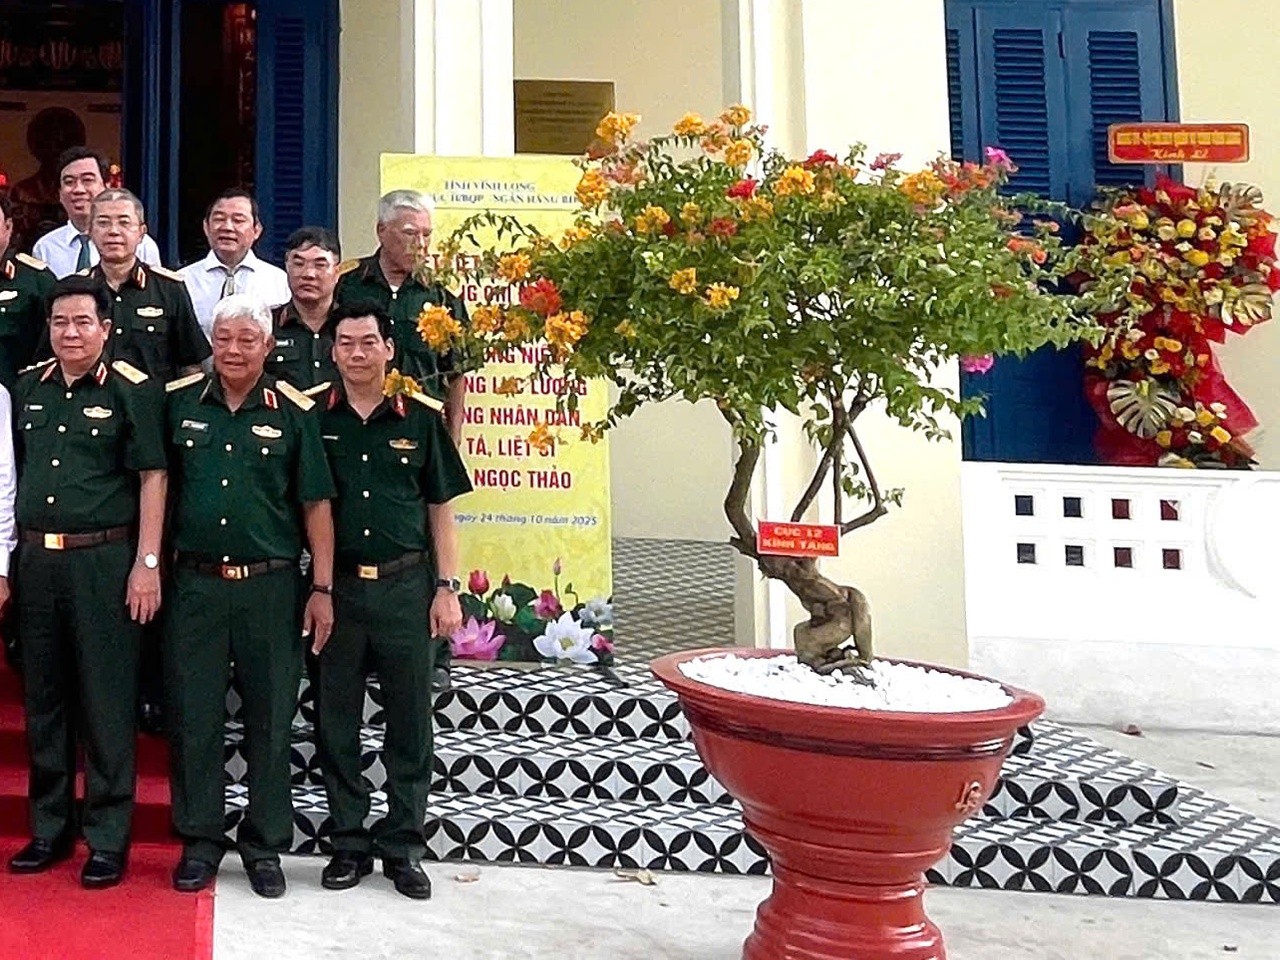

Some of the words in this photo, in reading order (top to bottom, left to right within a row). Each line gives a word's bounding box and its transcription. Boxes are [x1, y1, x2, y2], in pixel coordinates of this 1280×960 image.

[490, 404, 538, 426] NHÂN
[466, 434, 492, 458] TÁ,
[498, 435, 531, 460] LIỆT
[474, 468, 521, 491] NGỌC
[527, 464, 572, 489] THẢO
